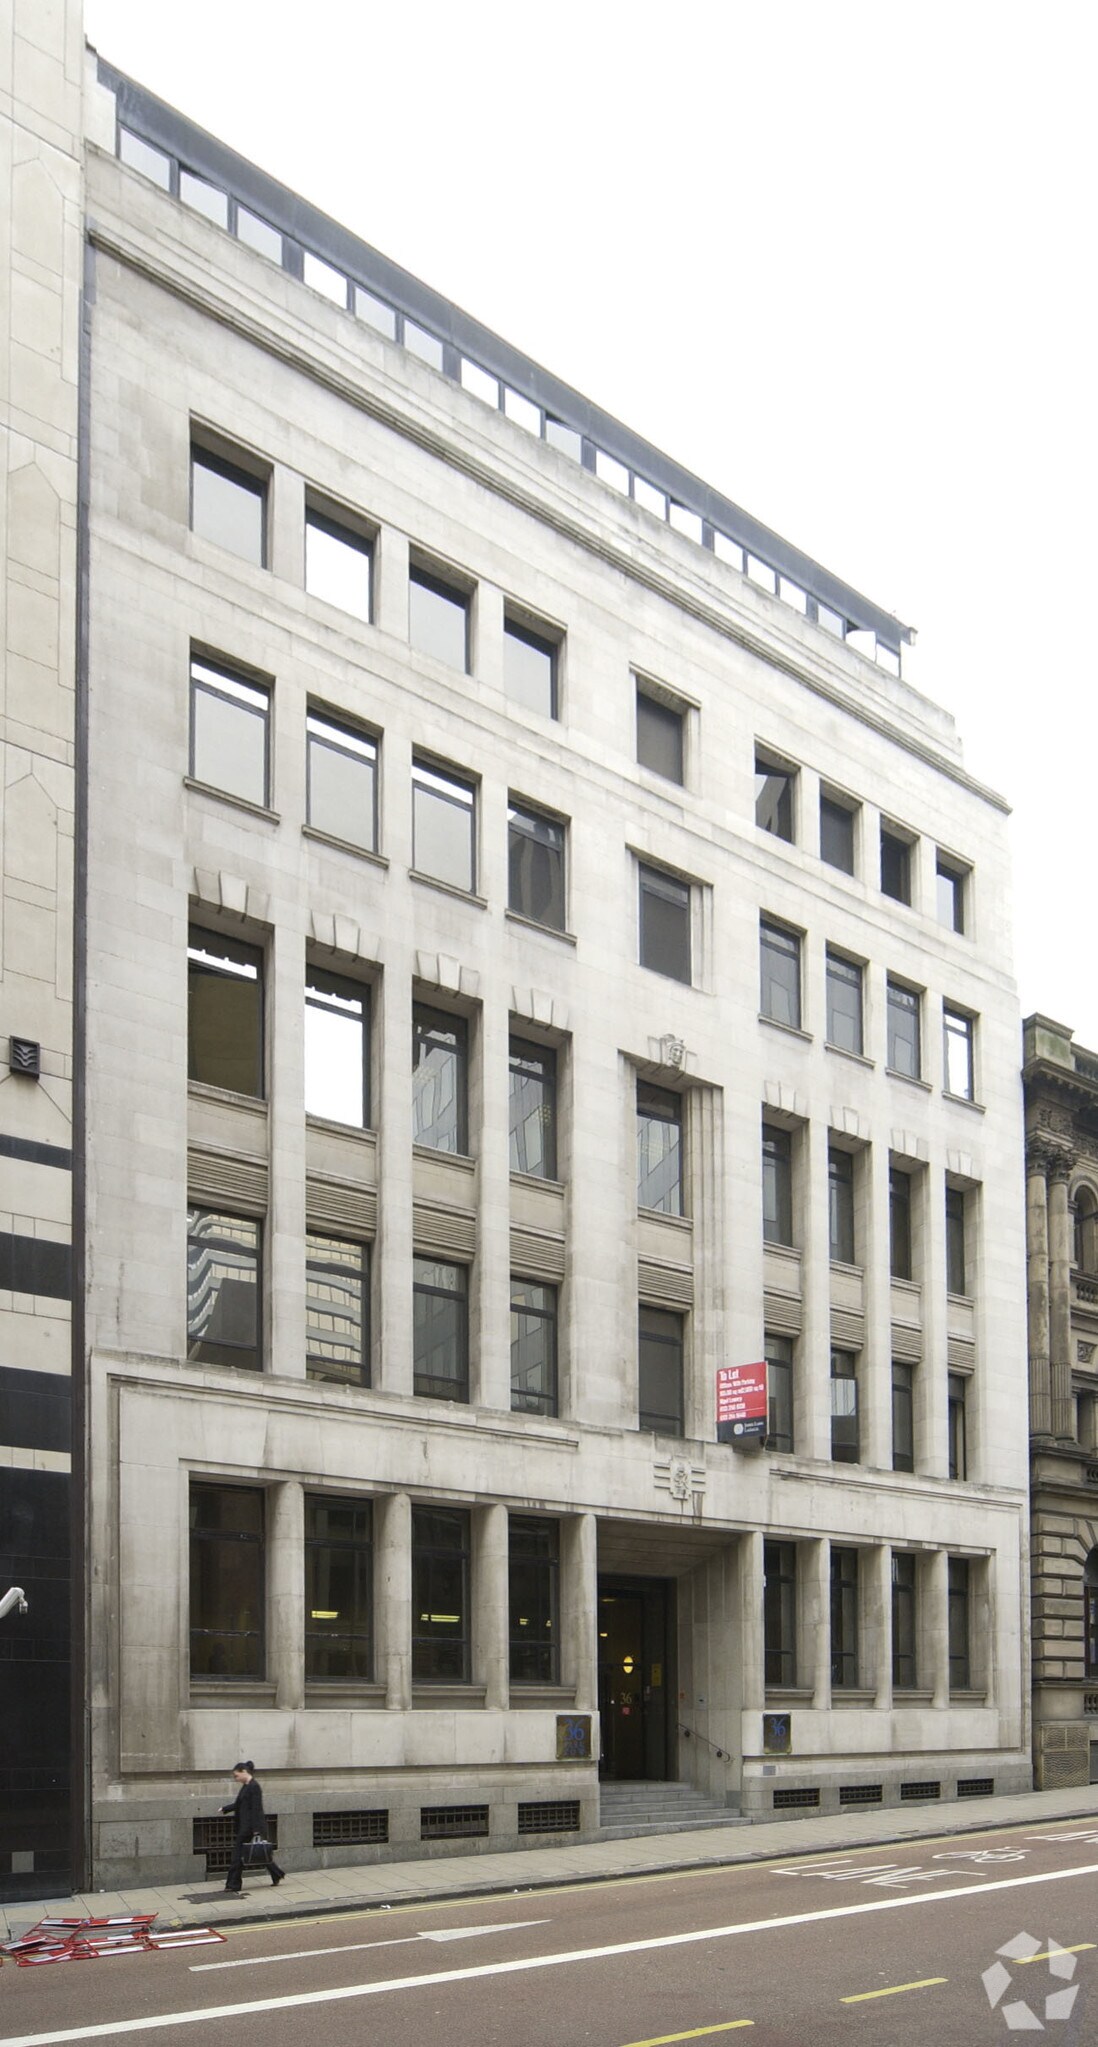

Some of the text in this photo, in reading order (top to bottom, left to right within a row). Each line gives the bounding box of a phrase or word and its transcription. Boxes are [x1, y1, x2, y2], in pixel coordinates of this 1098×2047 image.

[719, 1369, 739, 1381] To Let
[620, 1692, 632, 1705] 36
[564, 1718, 585, 1741] 36
[769, 1716, 787, 1737] 36
[770, 1859, 986, 1889] LANE
